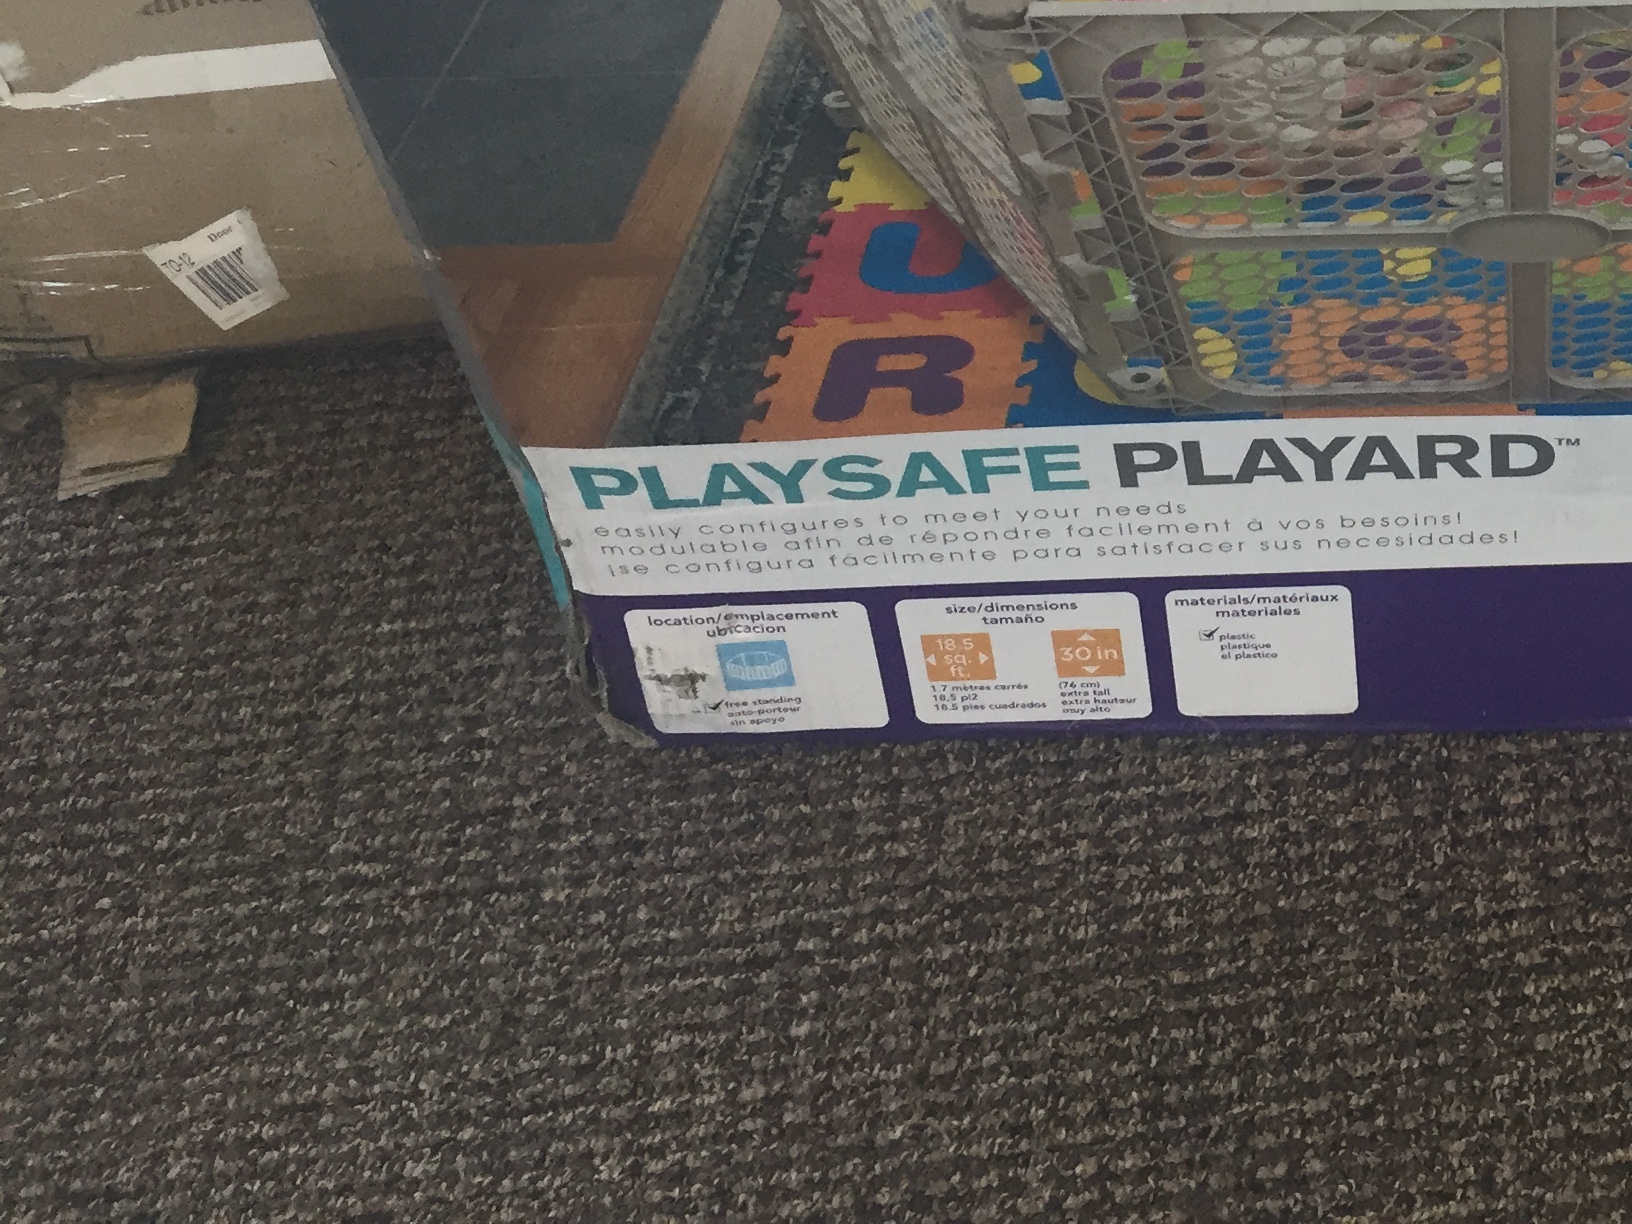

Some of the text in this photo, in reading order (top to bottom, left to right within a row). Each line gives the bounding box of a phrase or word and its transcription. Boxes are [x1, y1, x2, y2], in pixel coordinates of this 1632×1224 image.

[811, 334, 976, 423] R
[568, 444, 1090, 511] PLAYSAFE
[594, 499, 1188, 540] easily configures to meet your needs
[600, 511, 1463, 557] modulable afin de répondre facilement à vos besoins!
[665, 556, 815, 575] configura
[1011, 546, 1081, 564] para
[1095, 538, 1246, 558] satisfacer
[1259, 539, 1303, 552] sus
[1316, 530, 1520, 551] necesidades!
[1174, 592, 1340, 607] materials/matériaux
[944, 600, 1079, 615] size/dimensions
[1215, 605, 1302, 618] materiales
[647, 608, 839, 628] location/emplacement
[981, 613, 1046, 626] tamaño
[1218, 632, 1257, 643] plastic
[1059, 645, 1120, 662] 30 in
[1219, 641, 1272, 652] plastique
[943, 653, 972, 667] sq.
[1220, 651, 1232, 660] el
[1060, 689, 1089, 698] extra
[724, 699, 749, 710] free
[988, 700, 1047, 711] cuadrados
[1061, 698, 1091, 707] extra
